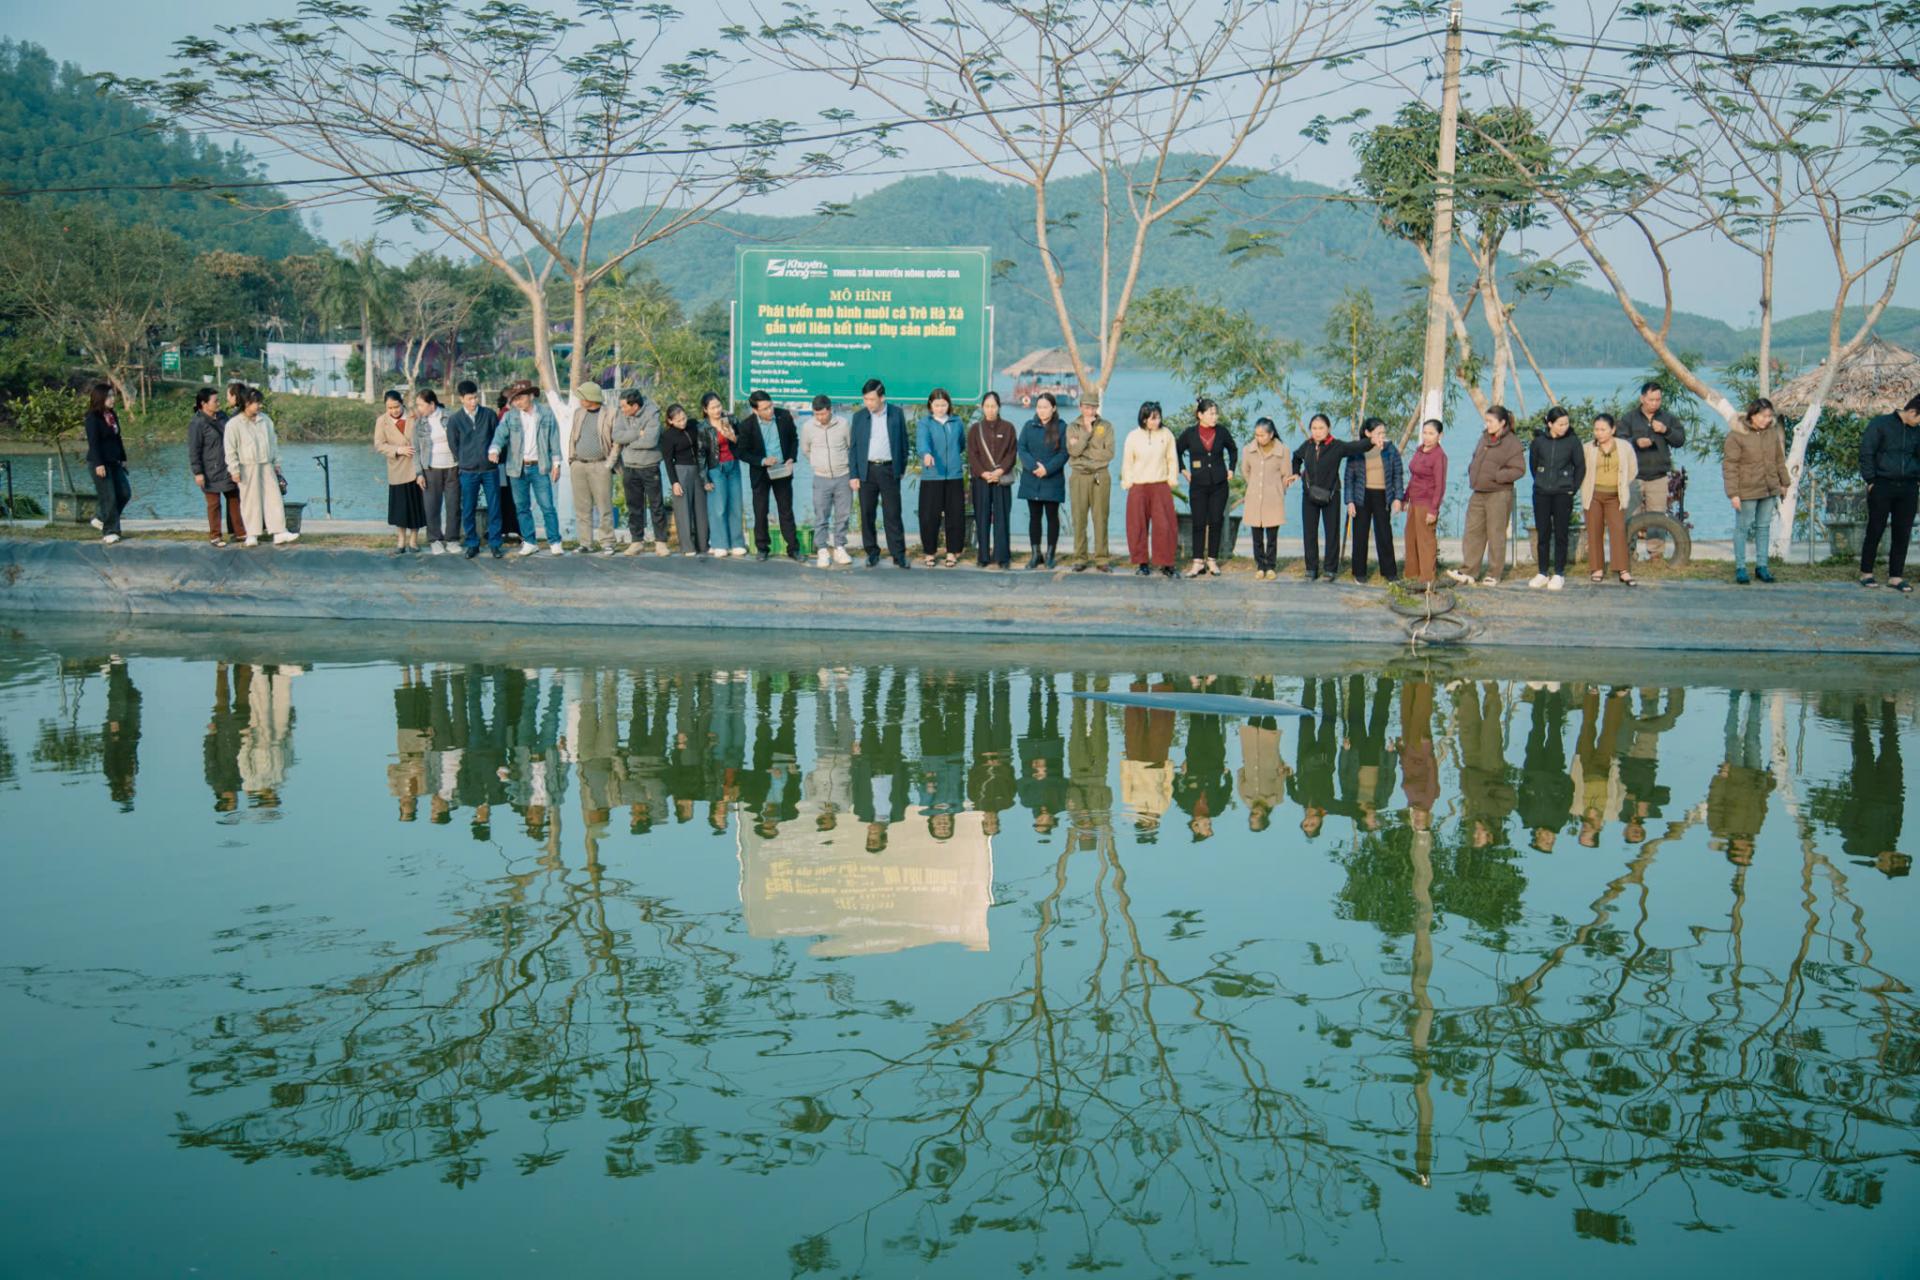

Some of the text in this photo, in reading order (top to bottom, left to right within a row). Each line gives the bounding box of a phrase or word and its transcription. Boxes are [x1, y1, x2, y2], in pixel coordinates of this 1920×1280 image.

[857, 268, 874, 278] TÂM
[926, 268, 946, 278] QUỐC
[947, 270, 960, 278] GIA
[830, 288, 892, 302] MÔ HÌNH
[758, 304, 784, 318] Phát
[786, 302, 813, 318] triển
[816, 305, 834, 318] mô
[836, 305, 862, 319] hình
[864, 305, 890, 319] nuôi
[892, 306, 906, 320] cá
[789, 321, 806, 334] với
[810, 321, 831, 334] liên
[833, 320, 852, 335] kết
[854, 322, 877, 336] tiêu
[879, 322, 898, 338] thụ
[900, 321, 921, 336] sản
[923, 320, 956, 338] phẩm
